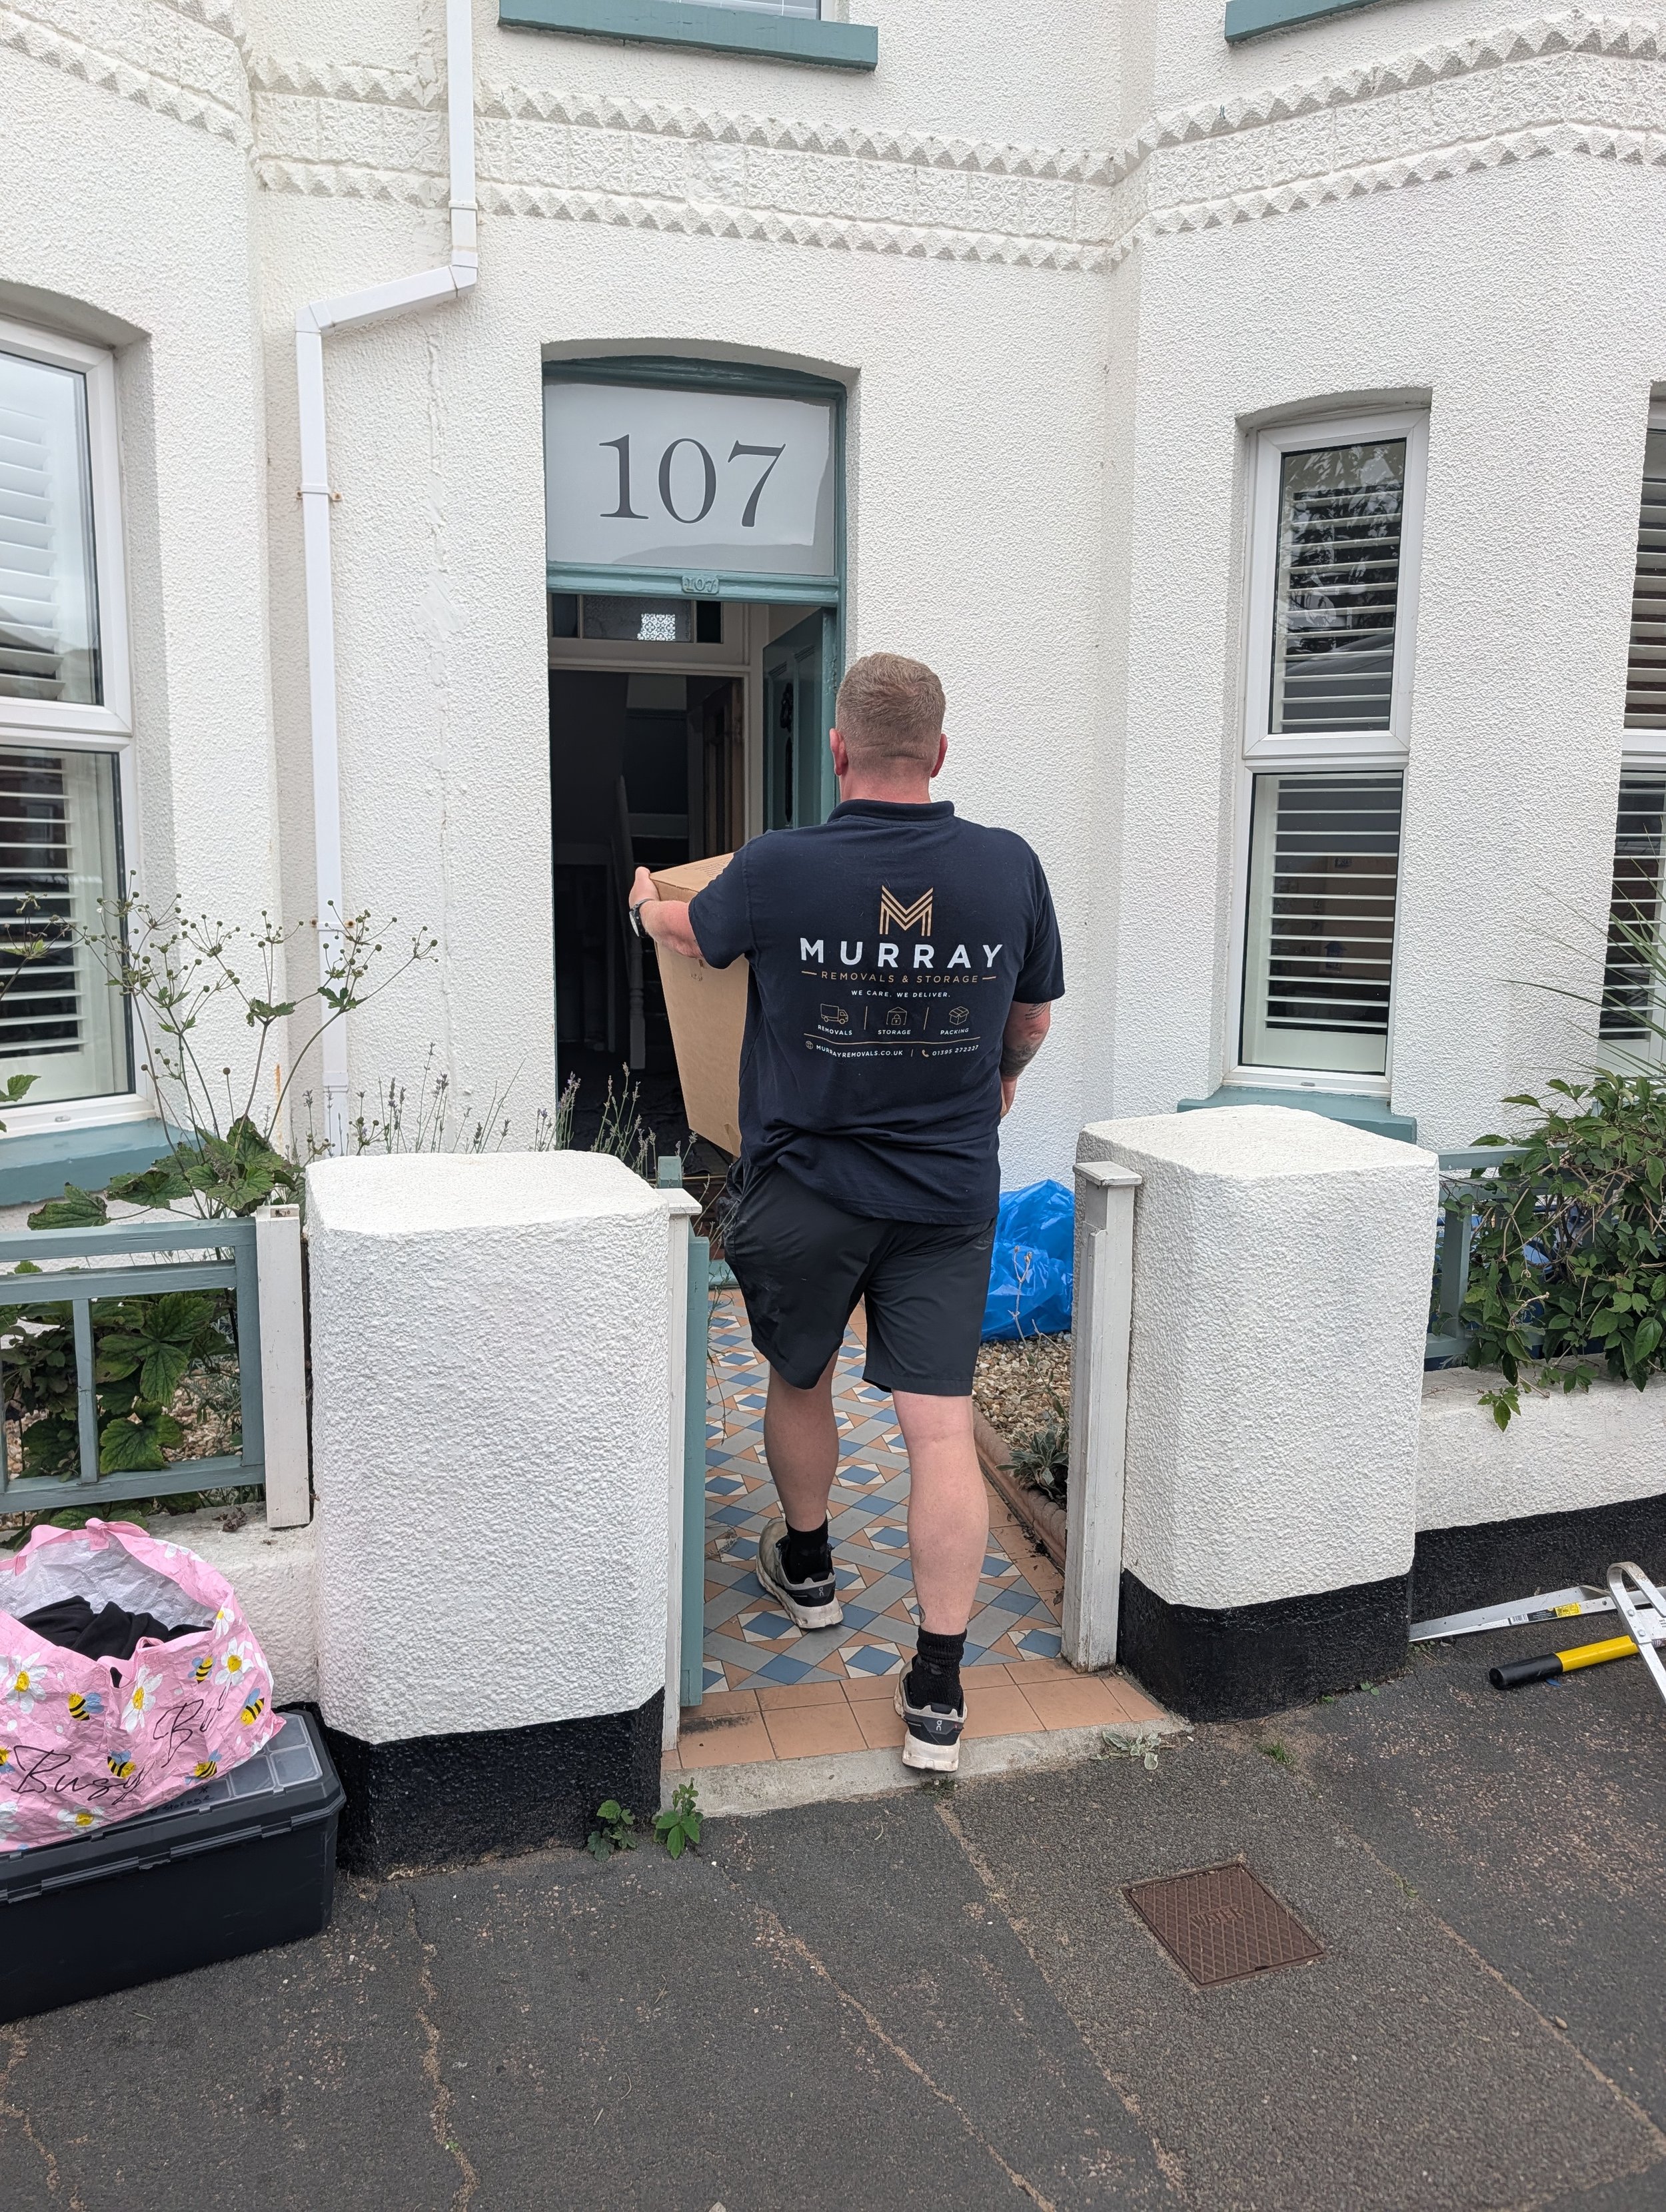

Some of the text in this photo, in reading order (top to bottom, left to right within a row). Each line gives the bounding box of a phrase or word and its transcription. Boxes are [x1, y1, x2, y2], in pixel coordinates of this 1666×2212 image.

[598, 434, 786, 528] 107
[684, 577, 716, 592] 107
[800, 937, 1003, 969] MURRAY
[821, 971, 894, 983] REMOVALS
[916, 975, 978, 983] STORAGE
[818, 1024, 852, 1036] REMOVALS
[816, 1045, 903, 1058] MURRAYREMOVALS.CO.UK
[954, 1045, 980, 1053] 272227
[11, 1745, 155, 1805] Busy
